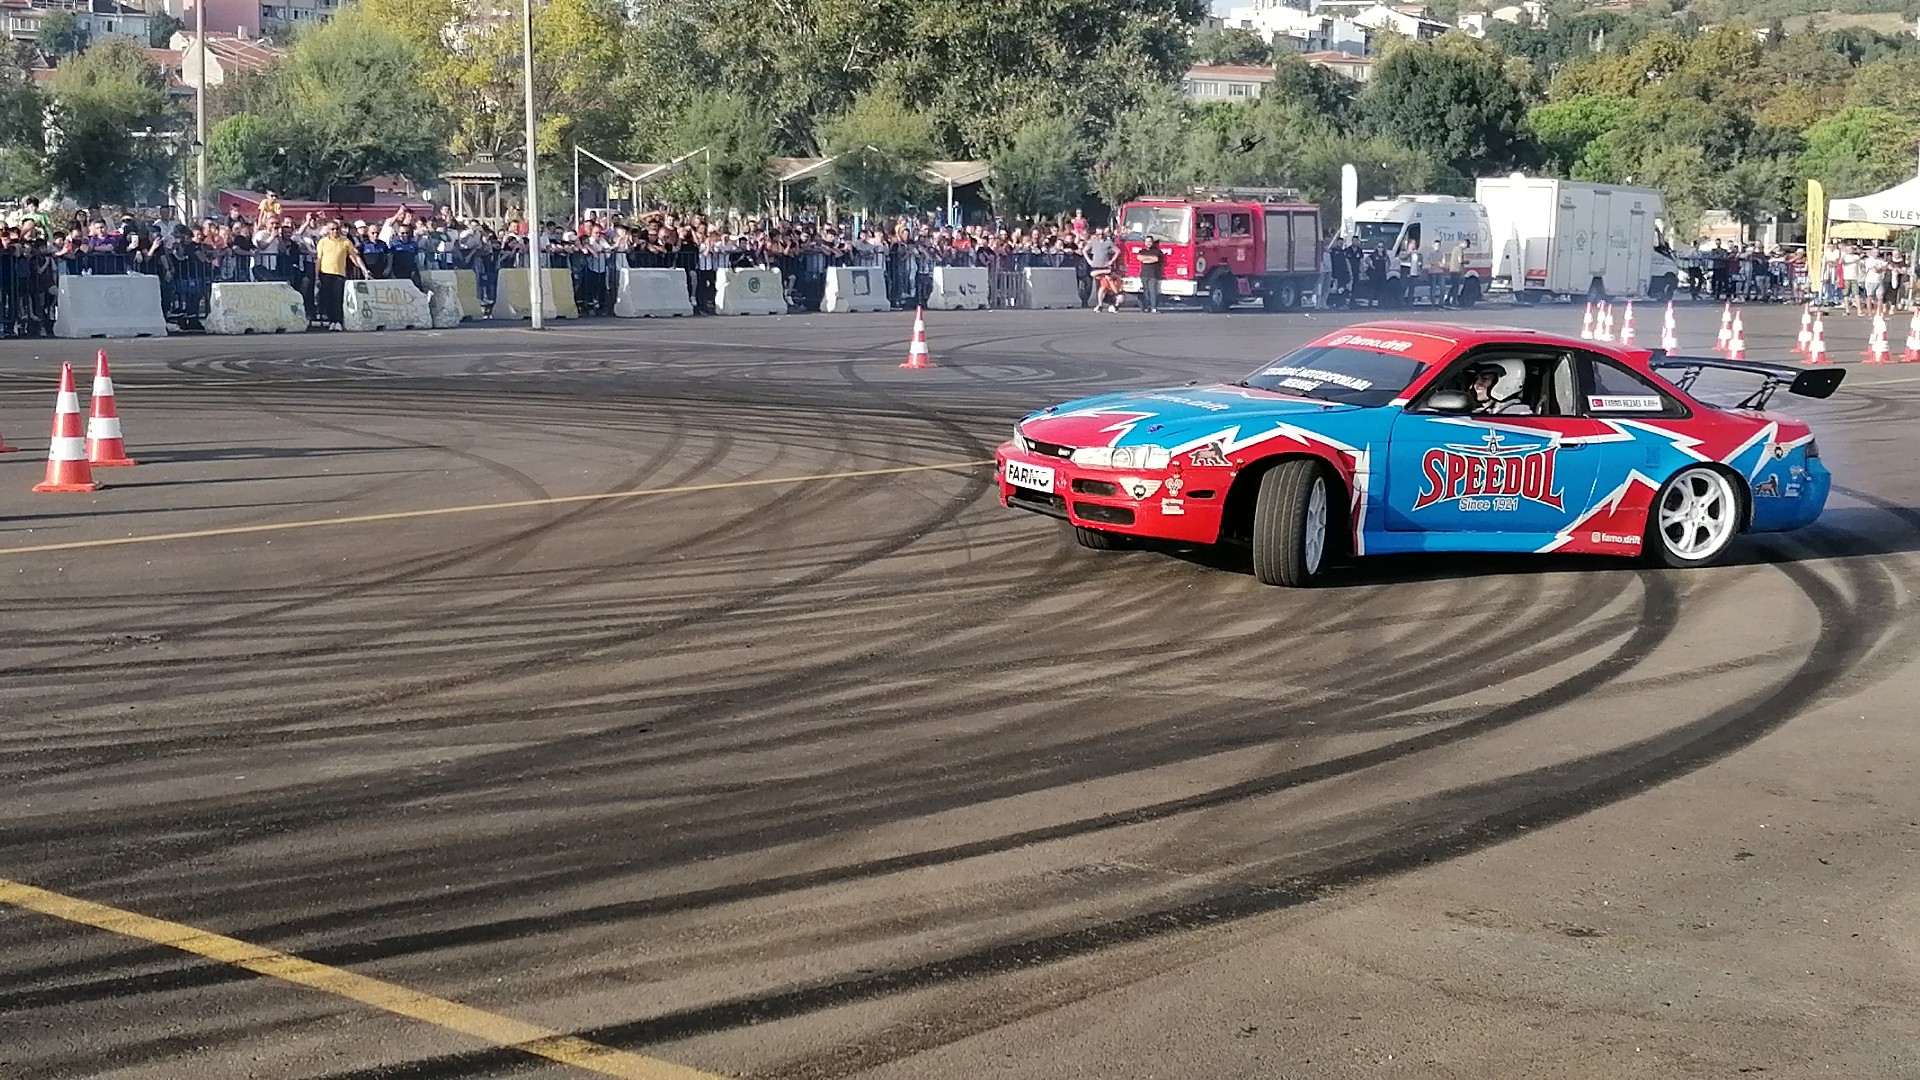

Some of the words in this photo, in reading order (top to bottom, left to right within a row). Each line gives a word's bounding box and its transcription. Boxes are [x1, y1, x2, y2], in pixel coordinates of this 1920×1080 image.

[1009, 464, 1050, 487] FARNO
[1411, 445, 1566, 514] SPEEDOL
[1458, 497, 1490, 512] Since
[1492, 497, 1519, 512] 1921
